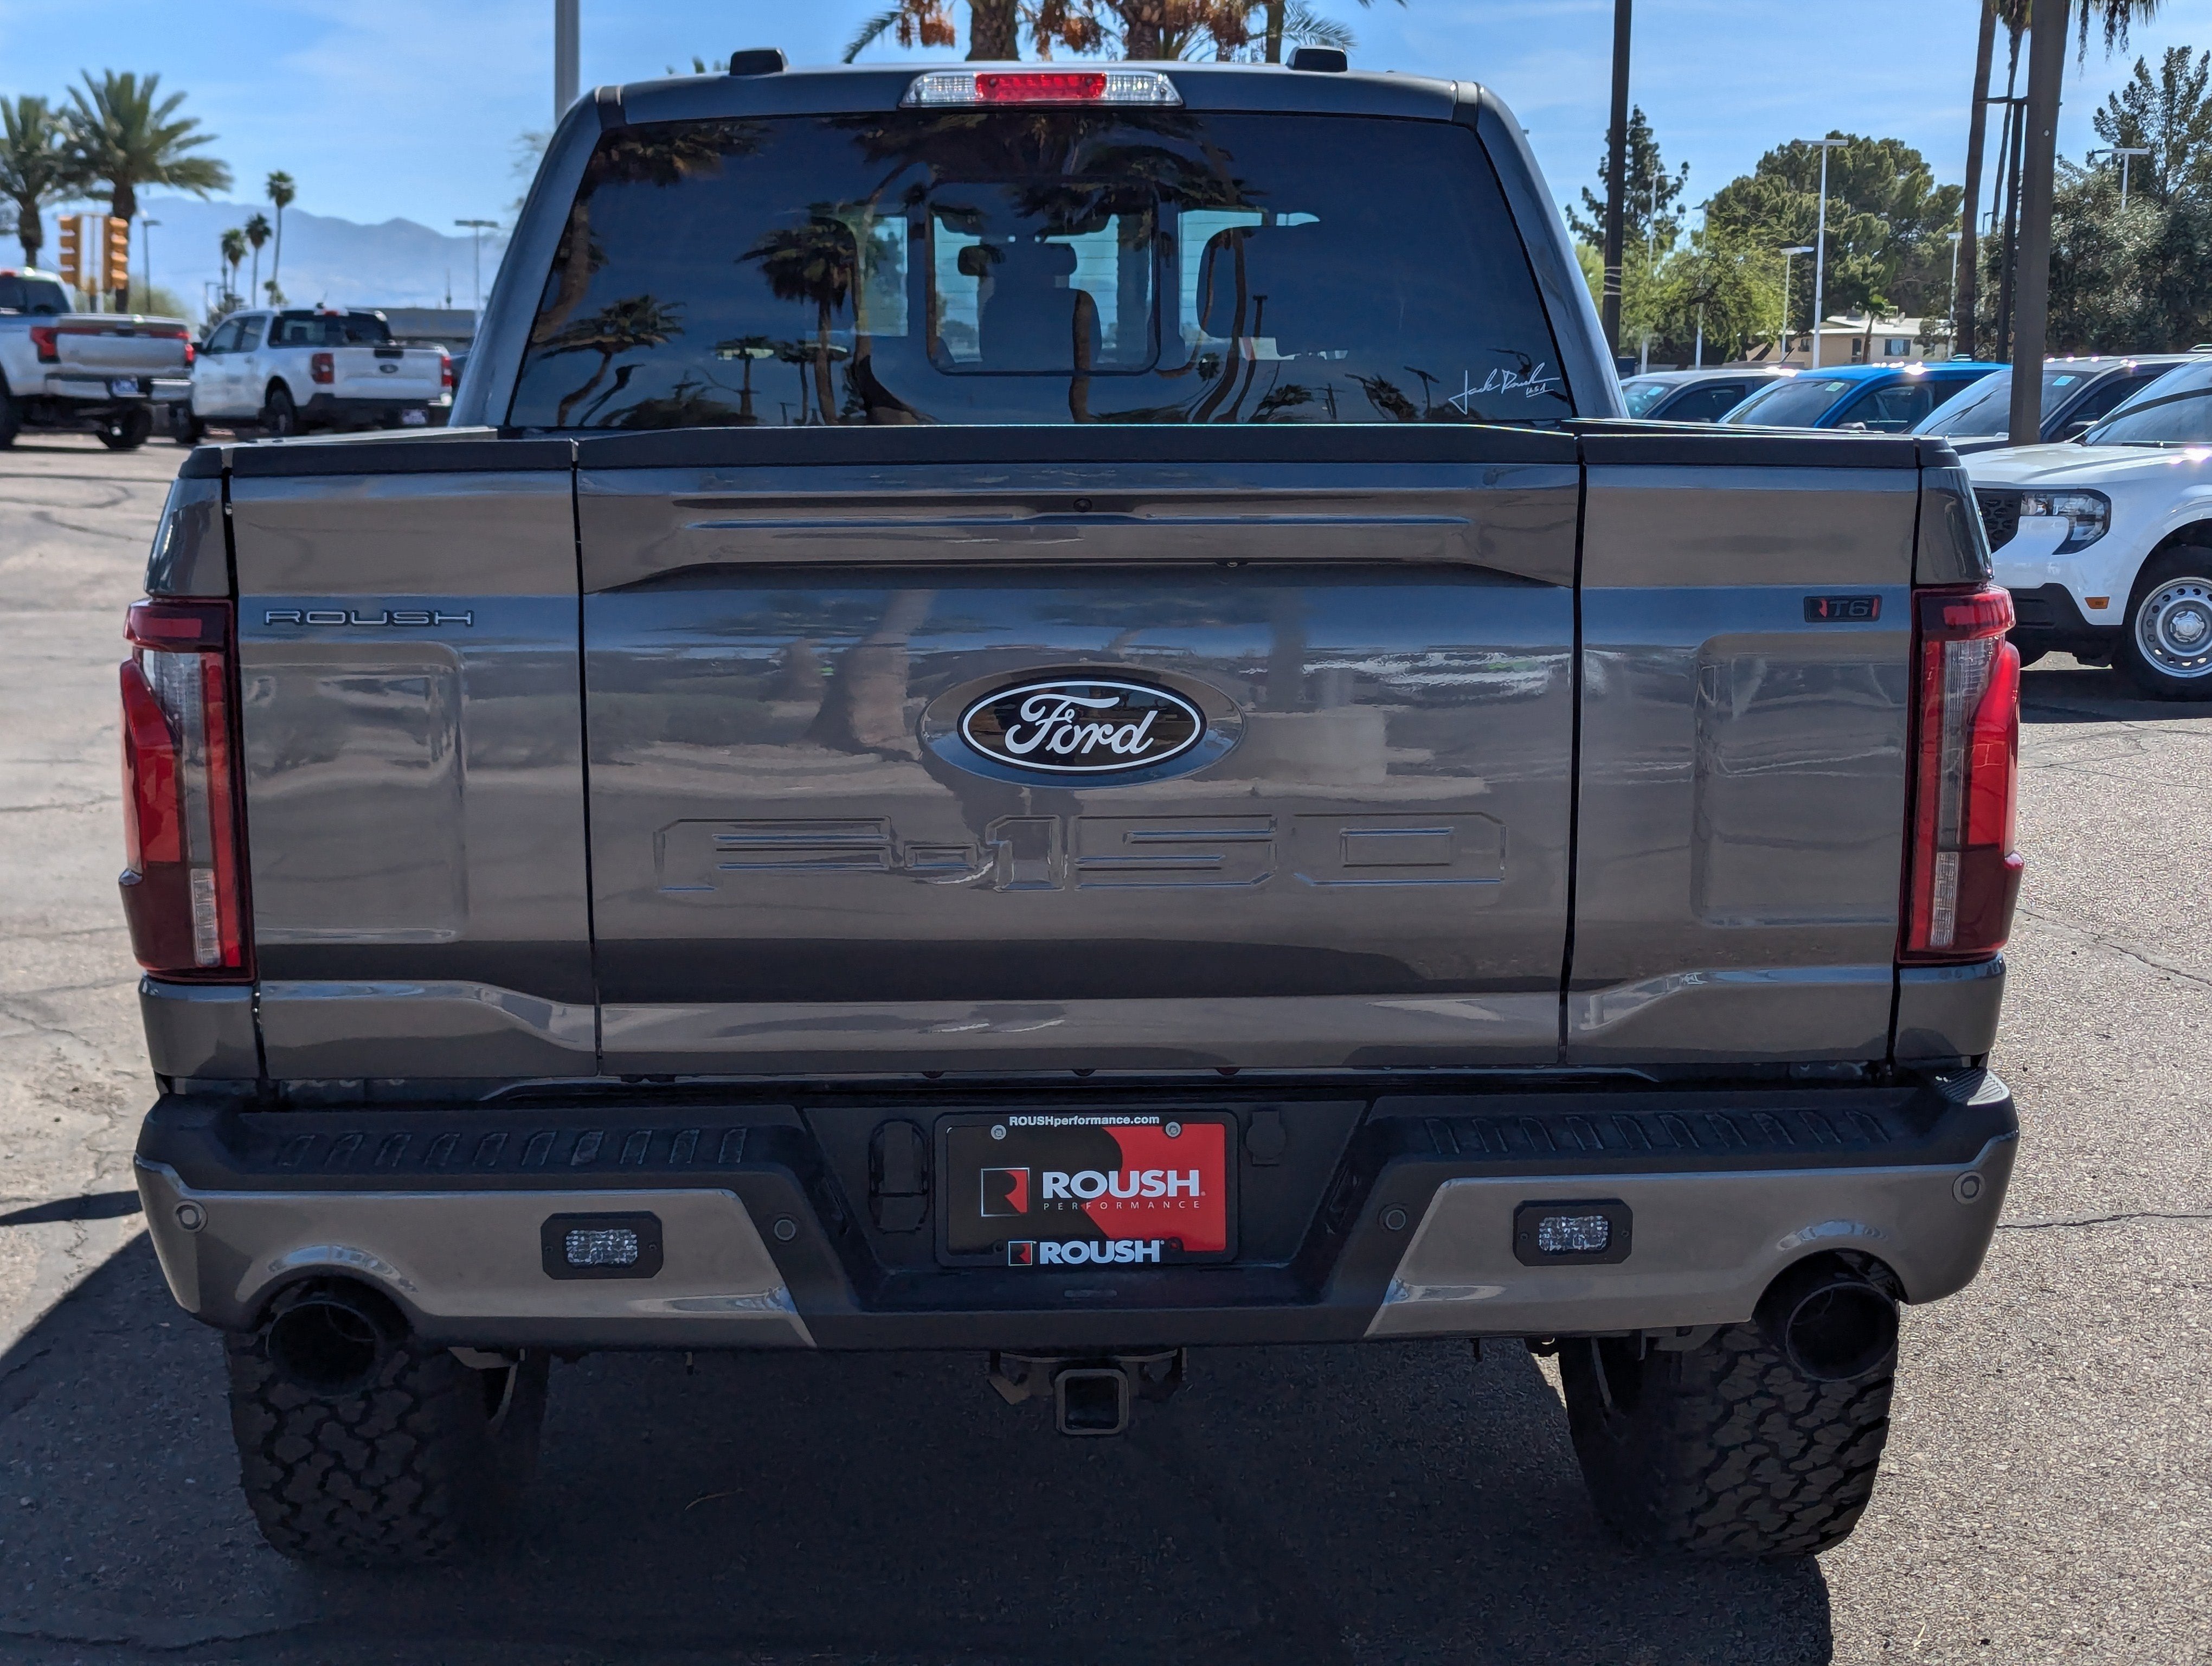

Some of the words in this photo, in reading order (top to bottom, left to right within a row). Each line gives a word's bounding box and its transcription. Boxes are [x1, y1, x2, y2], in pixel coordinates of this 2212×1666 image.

[265, 611, 472, 625] ROUSH
[1829, 599, 1870, 617] T6
[1004, 693, 1158, 754] Ford
[653, 811, 1507, 892] F-150
[1008, 1114, 1160, 1127] ROUSHperformance.com
[1043, 1169, 1200, 1199] ROUSH
[1044, 1201, 1200, 1210] PERFORMANCE
[1039, 1240, 1161, 1265] ROUSH
